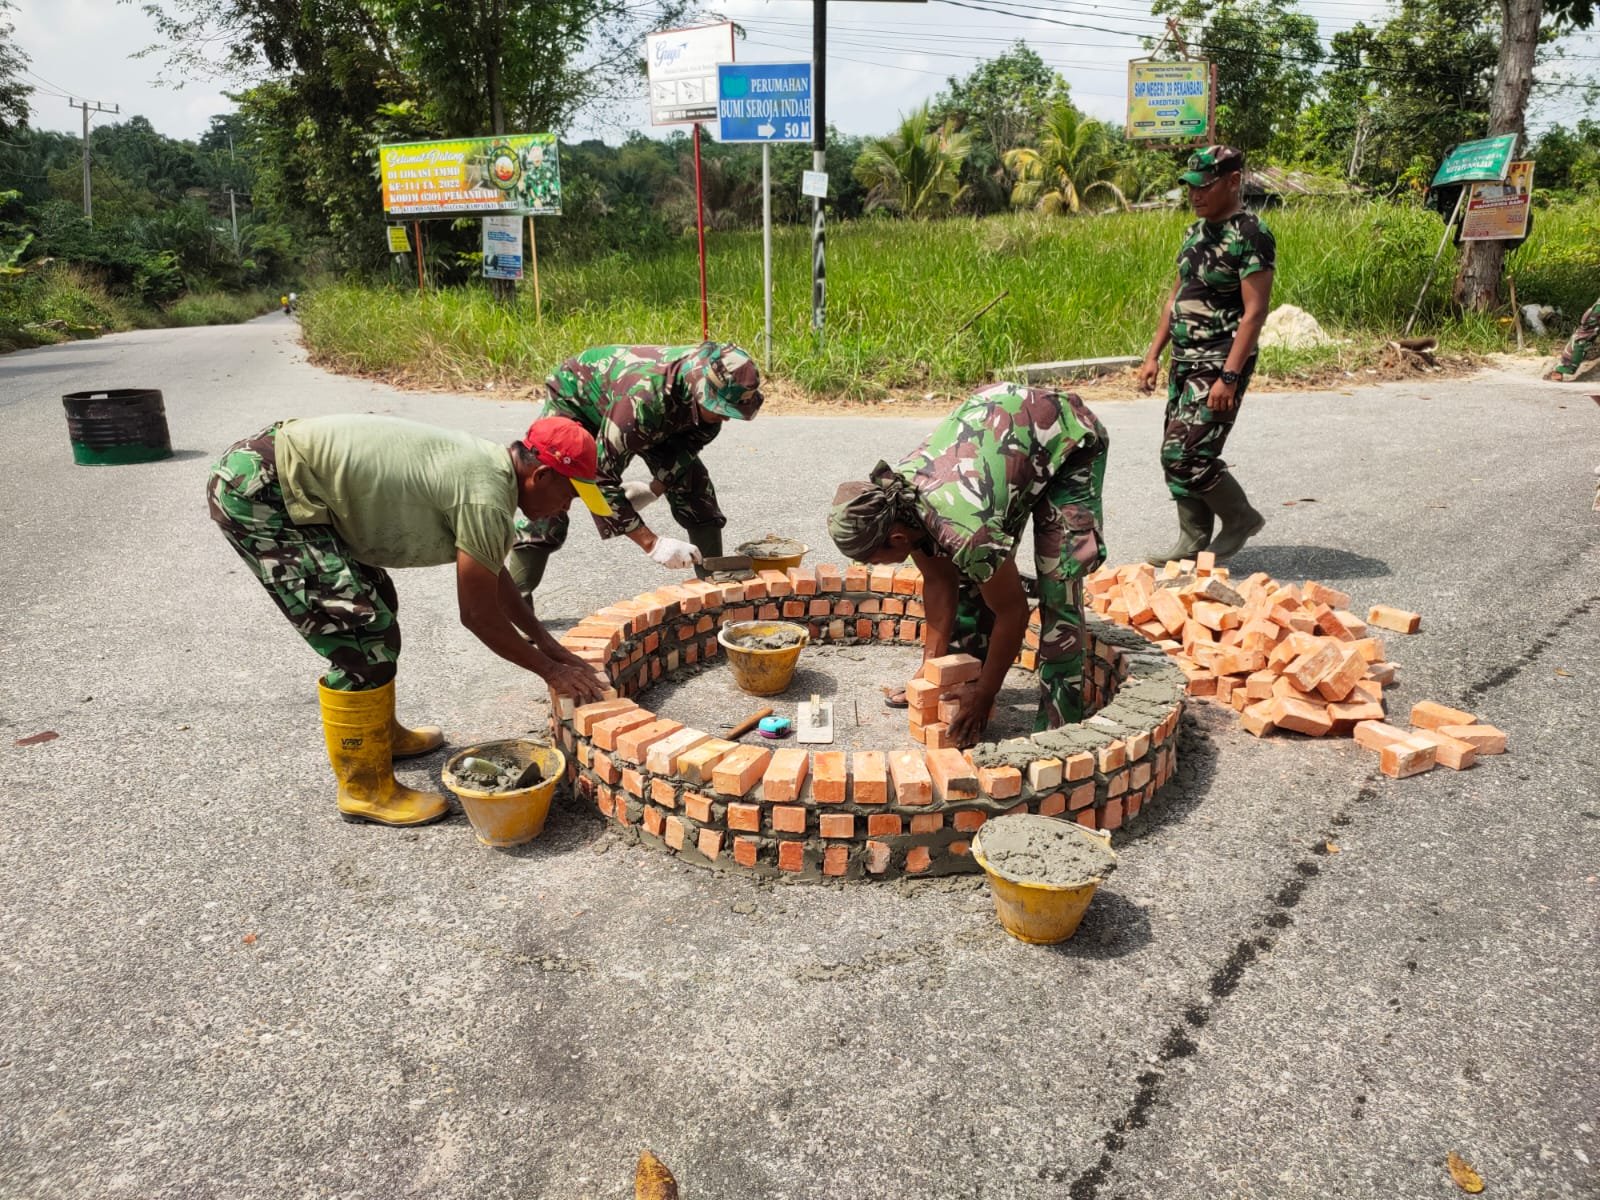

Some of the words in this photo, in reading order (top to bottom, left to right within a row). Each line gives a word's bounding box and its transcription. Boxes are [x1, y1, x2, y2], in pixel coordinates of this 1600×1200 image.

[751, 78, 808, 92] PERUMAHAN
[1135, 82, 1146, 97] SMP
[1147, 81, 1165, 97] NEGERI
[1174, 81, 1203, 96] PEKANBARU
[721, 99, 744, 118] BUMI
[746, 99, 779, 123] SEROJA
[781, 98, 811, 117] INDAH
[784, 122, 799, 138] 50
[801, 121, 810, 138] M
[386, 150, 427, 168] Selamat
[388, 170, 398, 179] DI
[400, 168, 431, 179] LOKASI
[434, 167, 460, 177] TMMD
[439, 179, 460, 189] 2022
[390, 192, 418, 203] KODIM
